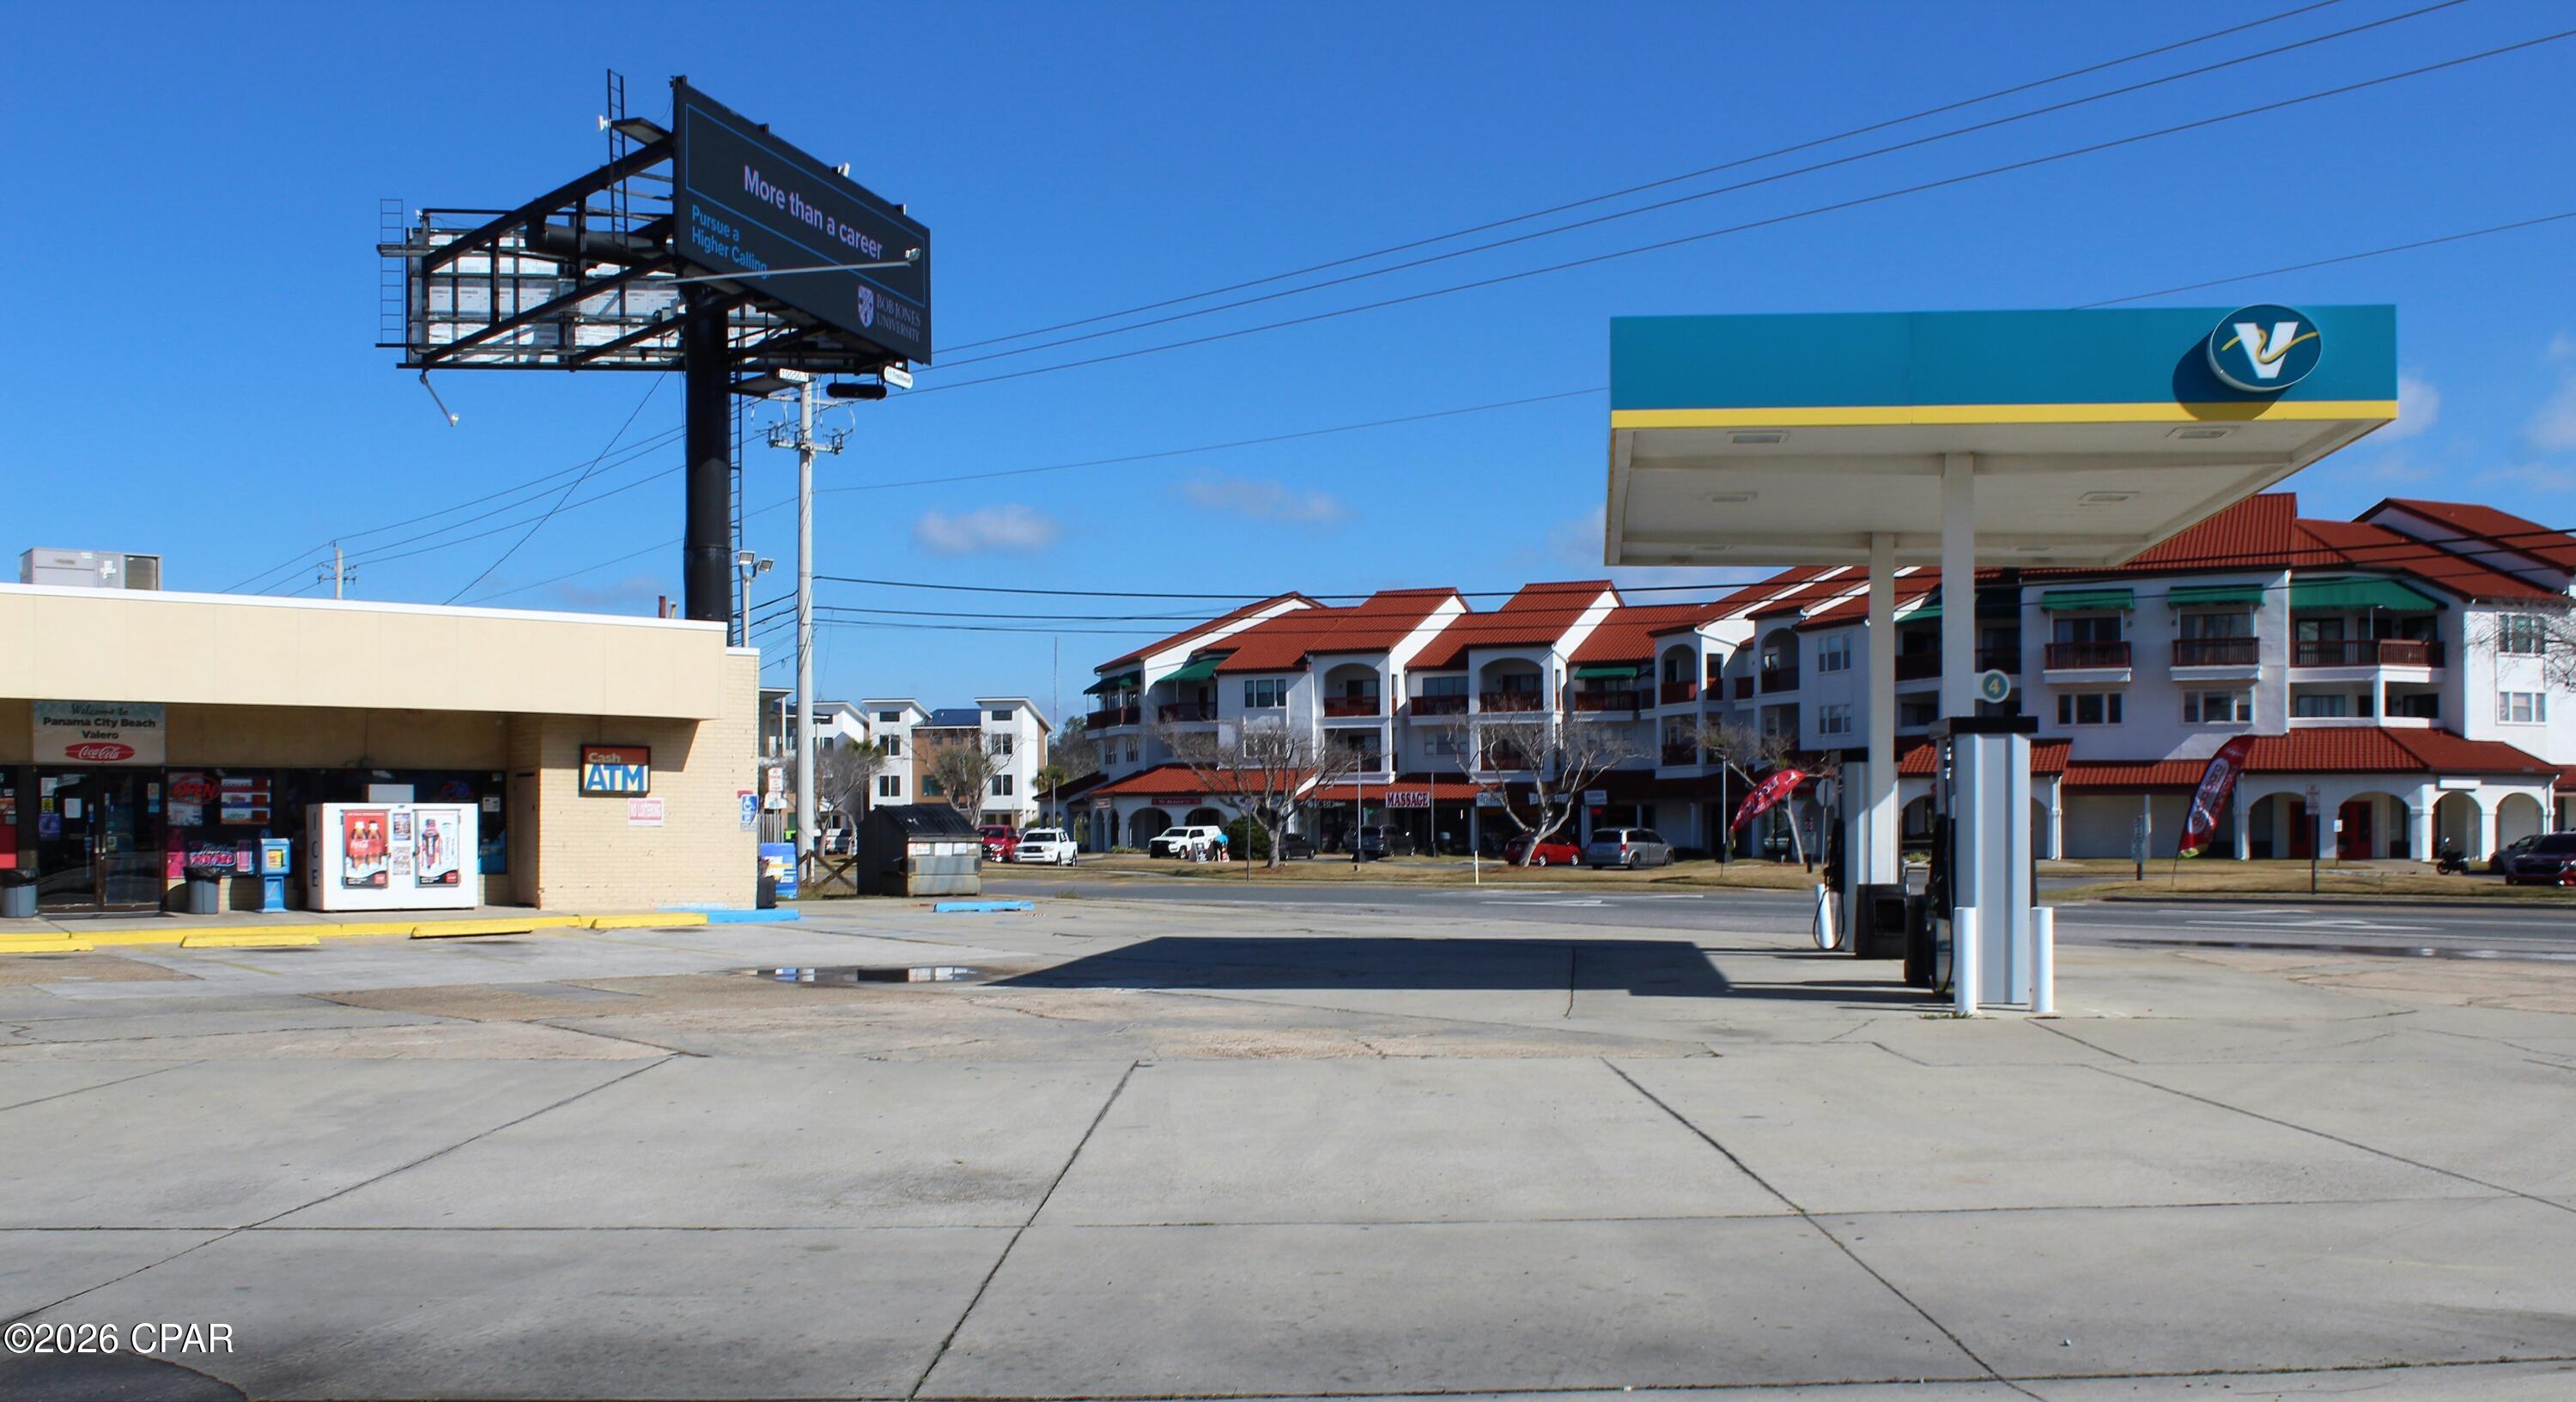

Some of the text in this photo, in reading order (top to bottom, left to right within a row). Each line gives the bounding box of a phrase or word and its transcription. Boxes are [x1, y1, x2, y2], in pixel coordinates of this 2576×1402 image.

[692, 204, 740, 241] Pursue a
[744, 164, 883, 260] More than a career
[692, 226, 729, 258] Higher
[877, 293, 921, 327] BOB JONES
[877, 312, 921, 343] UNIVERSITY
[1988, 677, 2001, 695] 4
[70, 703, 114, 716] Welcome
[44, 717, 156, 729] Panama City Beach
[82, 730, 119, 740] Valero
[588, 752, 621, 763] Cash
[585, 763, 644, 791] ATM
[172, 781, 216, 798] OPEN
[1387, 792, 1429, 808] MASSAGE
[311, 811, 319, 888] ICE
